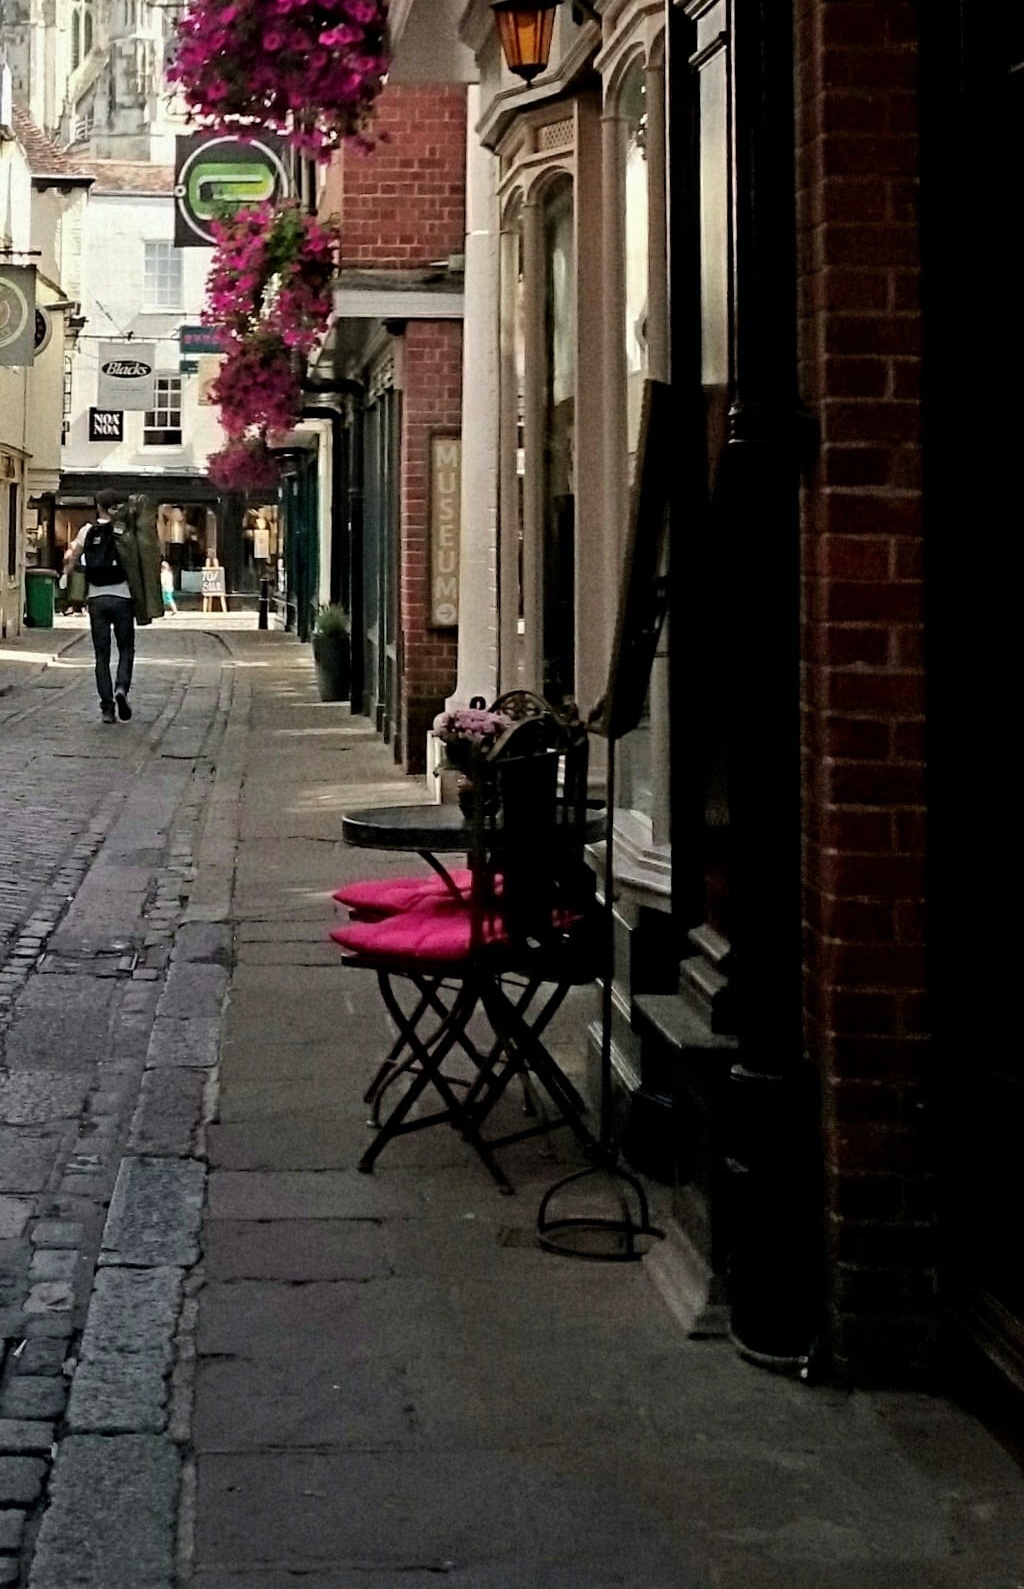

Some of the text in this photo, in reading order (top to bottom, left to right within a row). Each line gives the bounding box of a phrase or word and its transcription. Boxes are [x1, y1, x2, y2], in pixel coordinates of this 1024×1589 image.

[106, 362, 148, 375] Blacks
[94, 413, 120, 424] NOA
[94, 424, 120, 436] NOA
[435, 445, 458, 599] MUSEUM
